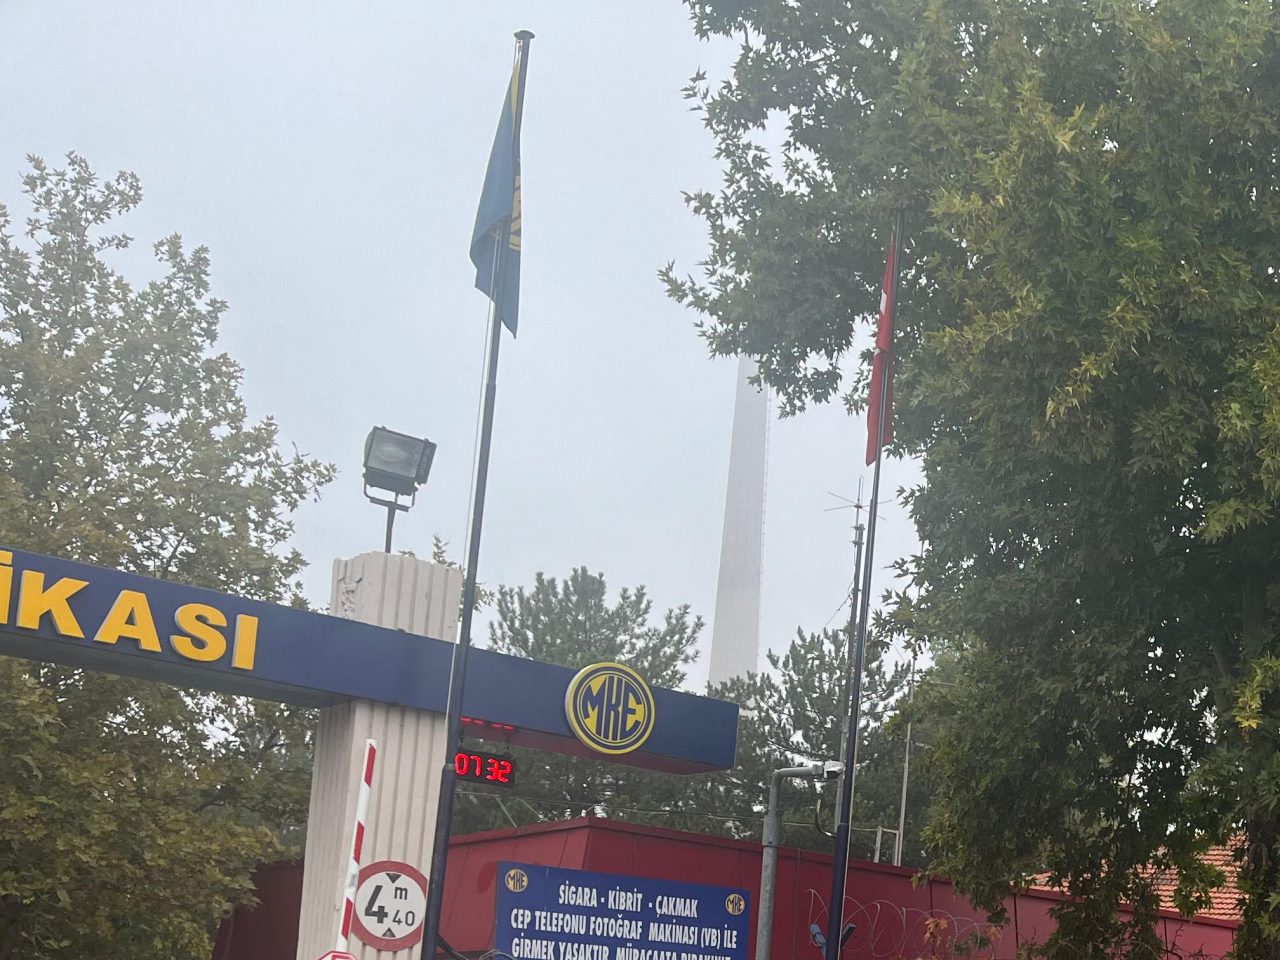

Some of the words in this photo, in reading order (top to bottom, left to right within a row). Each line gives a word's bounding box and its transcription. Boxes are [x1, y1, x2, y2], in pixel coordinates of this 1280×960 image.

[581, 675, 643, 742] MKE
[393, 886, 409, 901] m
[506, 870, 527, 892] MKE
[364, 884, 389, 924] 4
[392, 909, 416, 927] 40
[558, 880, 598, 908] SİGARA
[607, 886, 643, 912] KİBRİT
[655, 895, 699, 918] ÇAKMAK
[726, 895, 744, 914] MKE
[510, 908, 532, 930] CEP
[534, 910, 587, 935] TELEFONU
[589, 913, 643, 940] FOTOĞRAF
[648, 918, 699, 946] MAKİNASI
[700, 927, 721, 949] (VB)
[723, 923, 738, 949] İLE
[512, 932, 555, 960] GİRMEK
